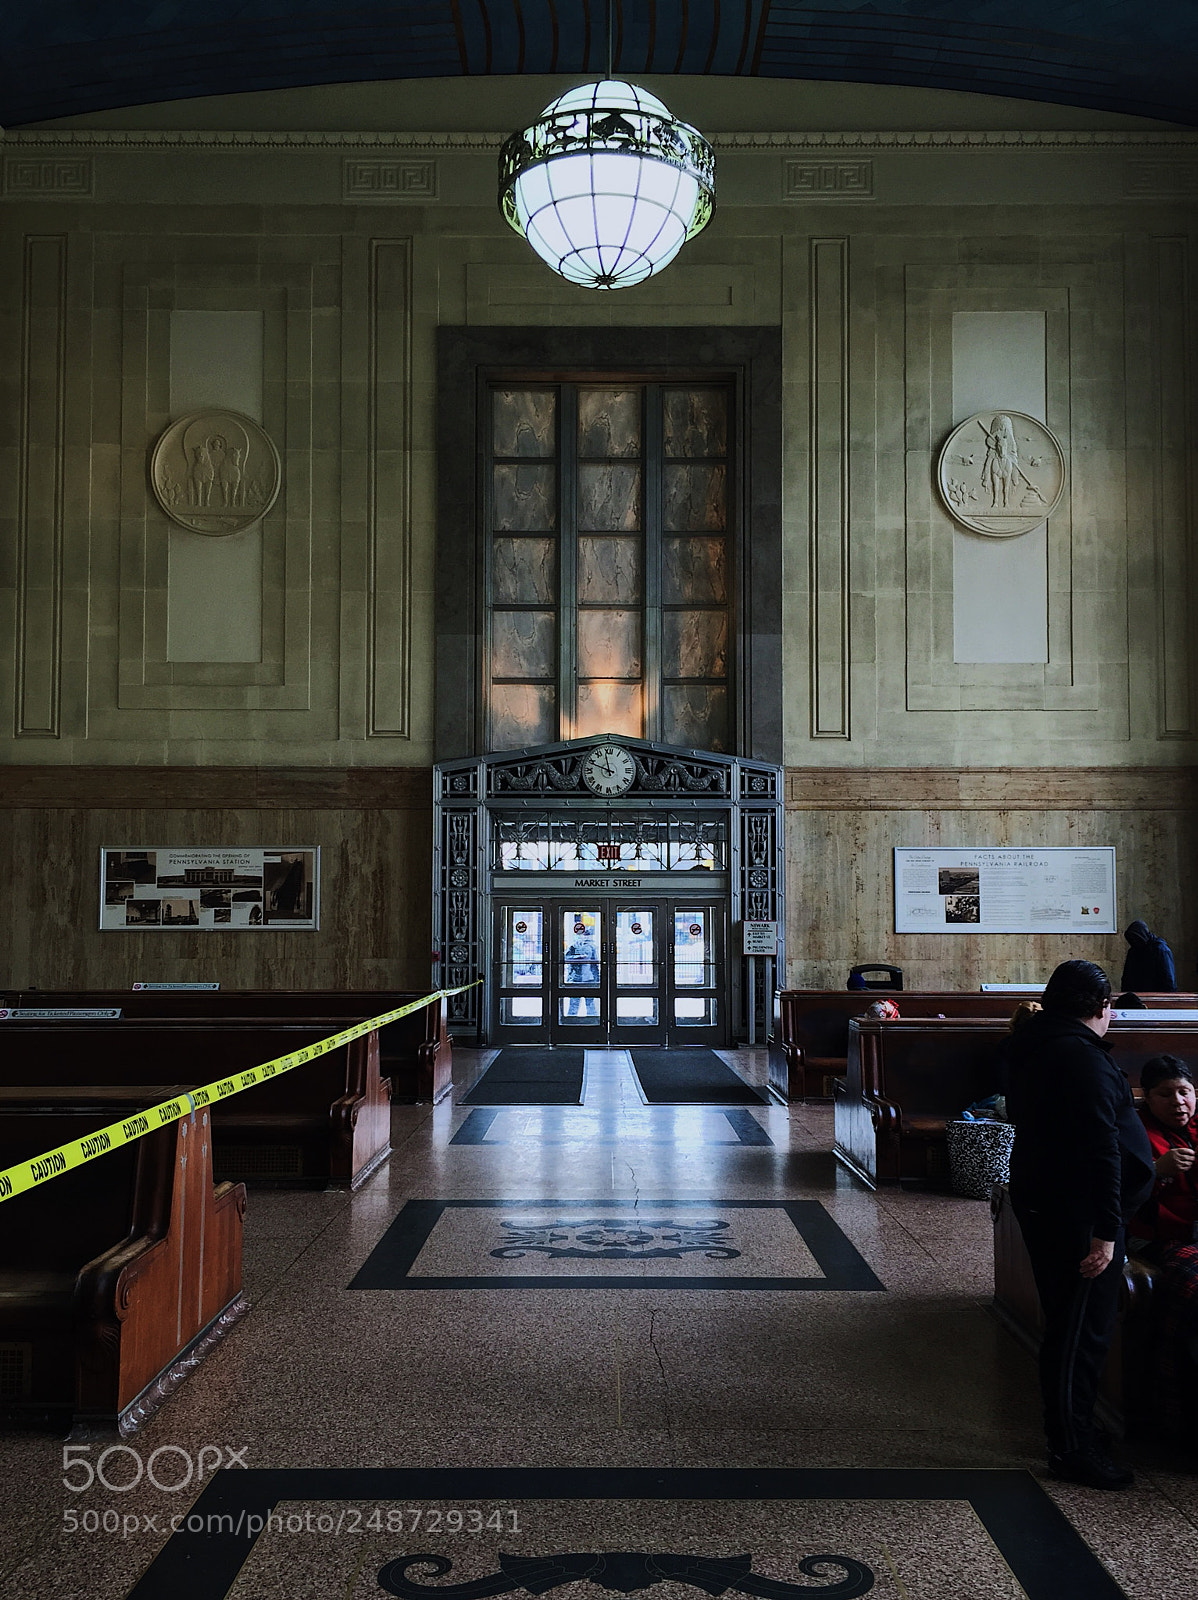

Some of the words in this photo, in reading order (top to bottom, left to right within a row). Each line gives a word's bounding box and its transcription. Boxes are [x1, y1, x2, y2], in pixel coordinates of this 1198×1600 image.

[600, 846, 618, 859] EXIT
[574, 879, 610, 887] MARKET
[612, 879, 642, 887] STREET
[30, 1152, 67, 1182] CAUTION
[80, 1132, 111, 1159] CAUTION
[122, 1116, 149, 1139] CAUTION
[158, 1101, 182, 1123] CAUTION
[192, 1090, 210, 1107] AUTION
[216, 1080, 235, 1097] CAUTION
[240, 1072, 256, 1087] CAUTION
[261, 1064, 276, 1078] CAUTION
